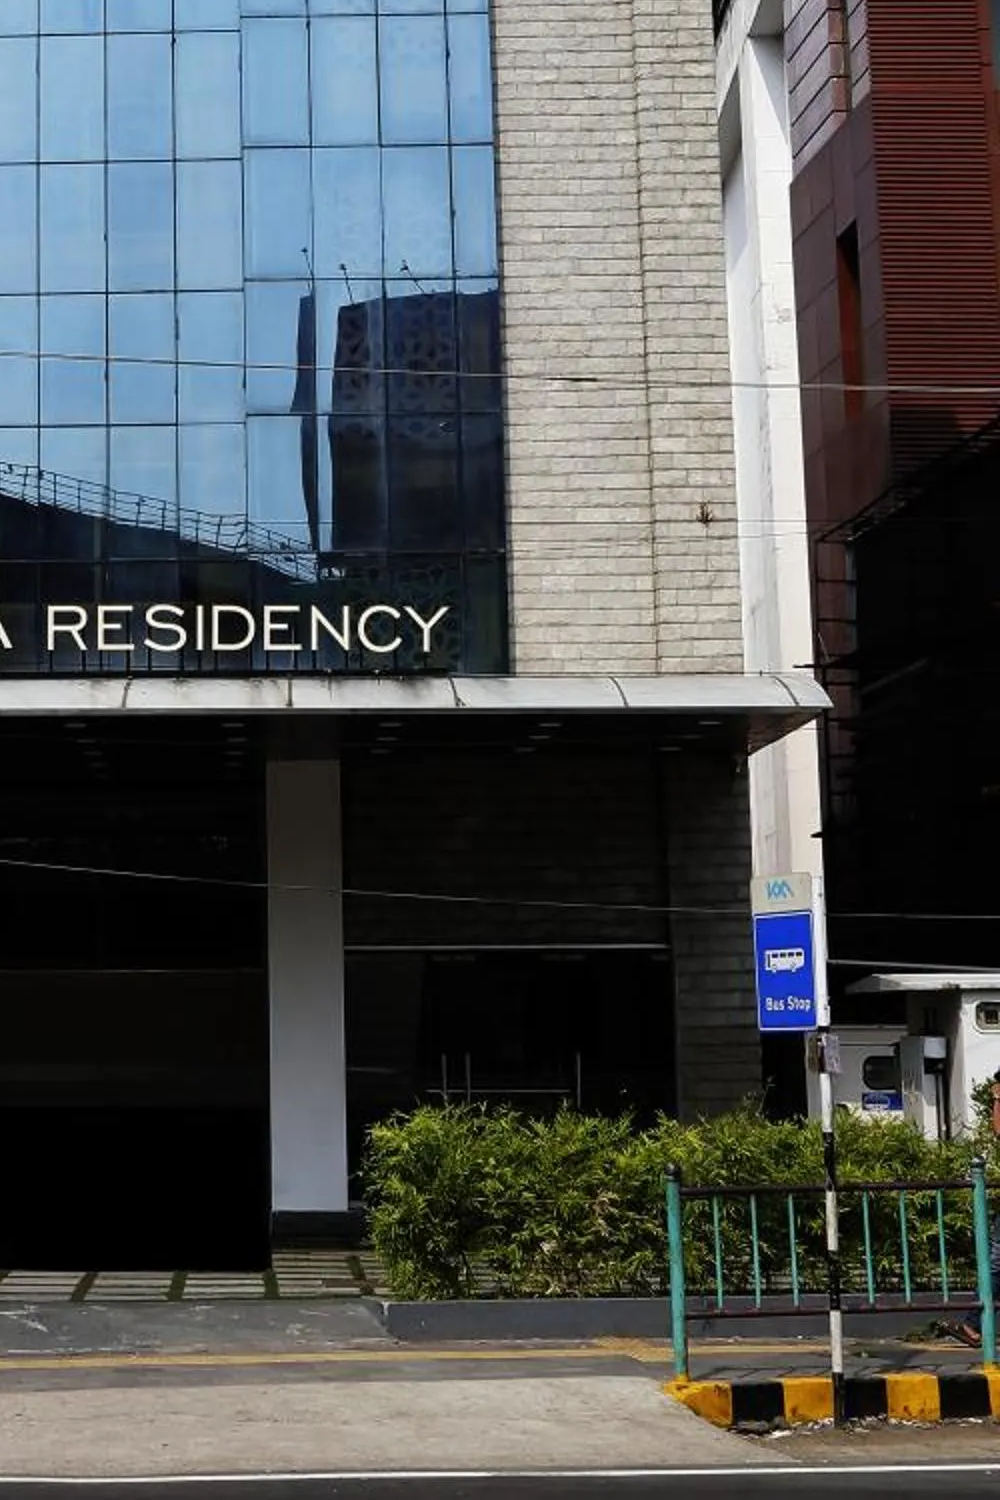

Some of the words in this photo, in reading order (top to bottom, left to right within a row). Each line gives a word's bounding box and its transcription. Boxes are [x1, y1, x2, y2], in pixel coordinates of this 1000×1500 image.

[46, 604, 451, 653] RESIDENCY
[765, 997, 785, 1011] Bus
[788, 995, 811, 1012] Stop
